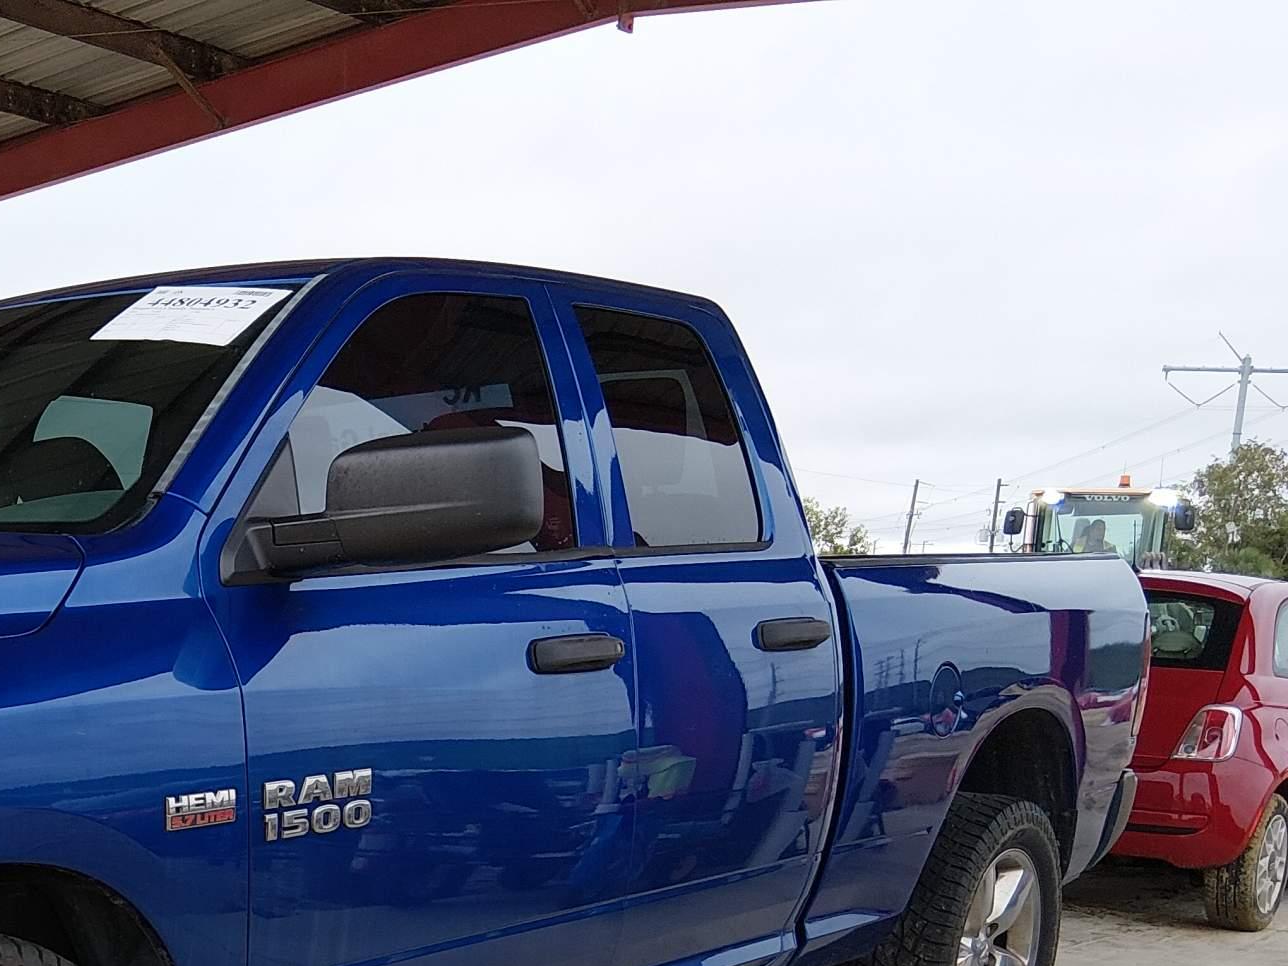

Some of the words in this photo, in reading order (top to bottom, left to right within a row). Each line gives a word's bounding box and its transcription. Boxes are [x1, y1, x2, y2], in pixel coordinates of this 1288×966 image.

[148, 296, 257, 310] 44804932
[1084, 494, 1130, 502] VOLVO
[166, 788, 237, 814] HEMI
[263, 767, 373, 810] RAM
[264, 799, 373, 842] 1500
